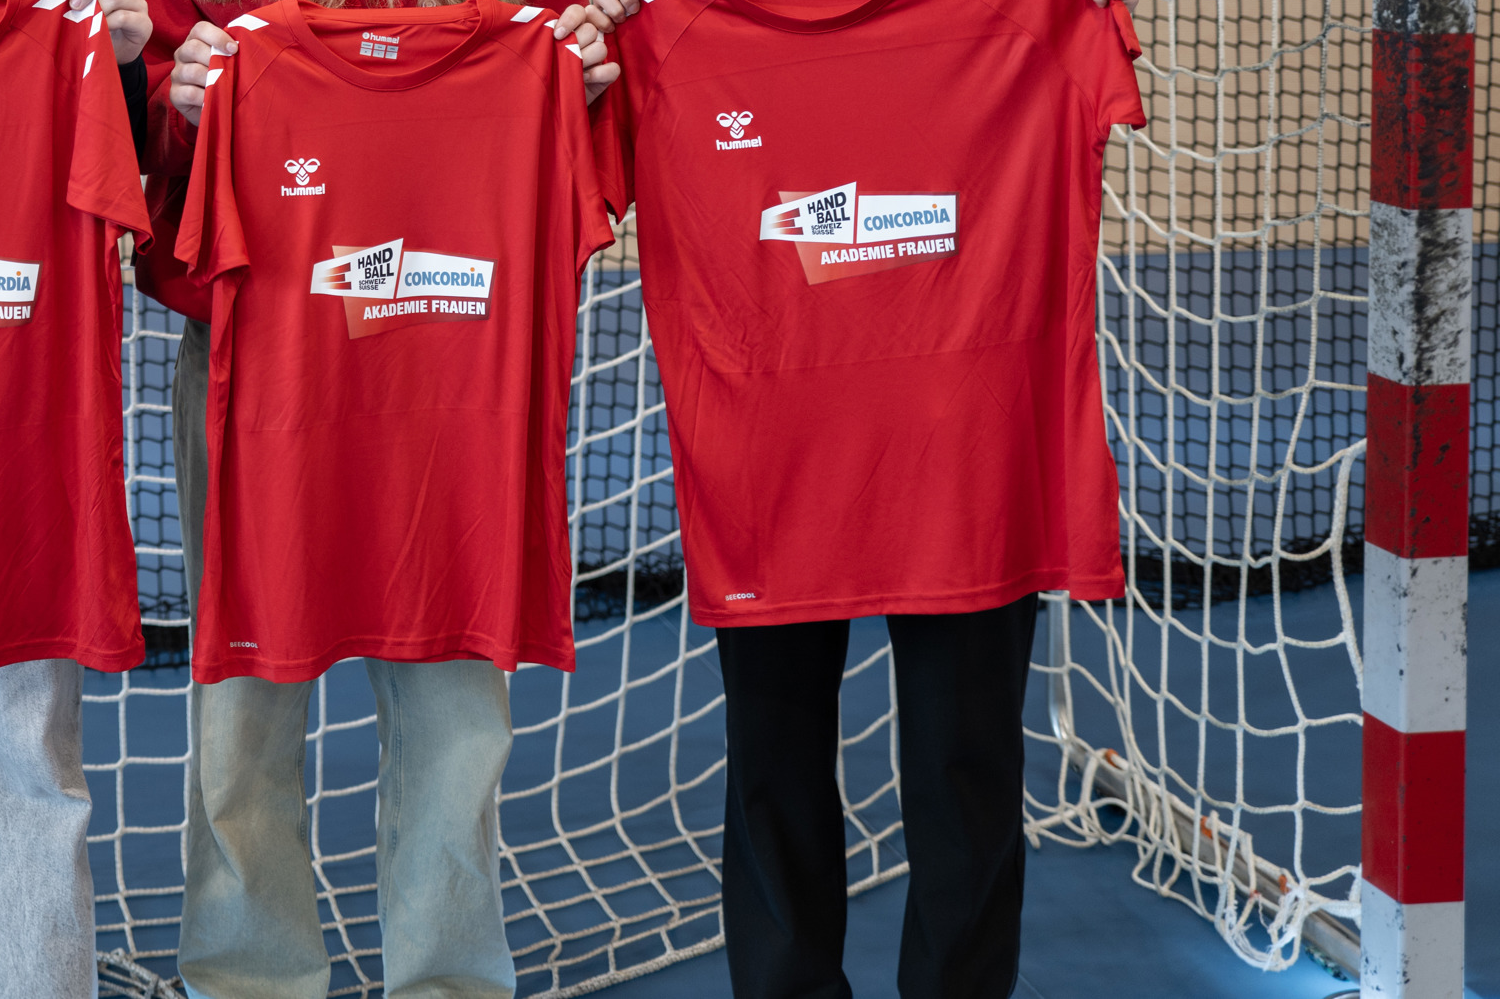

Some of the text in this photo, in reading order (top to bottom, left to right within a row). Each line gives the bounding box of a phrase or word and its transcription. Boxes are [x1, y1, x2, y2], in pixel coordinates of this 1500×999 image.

[370, 32, 399, 44] hummel
[716, 136, 762, 150] hummel
[281, 183, 325, 196] hummel
[807, 192, 847, 214] HAND
[816, 207, 851, 224] BALL
[811, 222, 843, 230] SCHWEIZ
[357, 247, 393, 270] HAND
[820, 237, 955, 265] AKADEMIE FRAUEN
[364, 262, 395, 279] BALL
[358, 278, 386, 286] SCHWEIZ
[363, 299, 486, 320] AKADEMIE FRAUEN
[725, 593, 756, 601] BEECOOL
